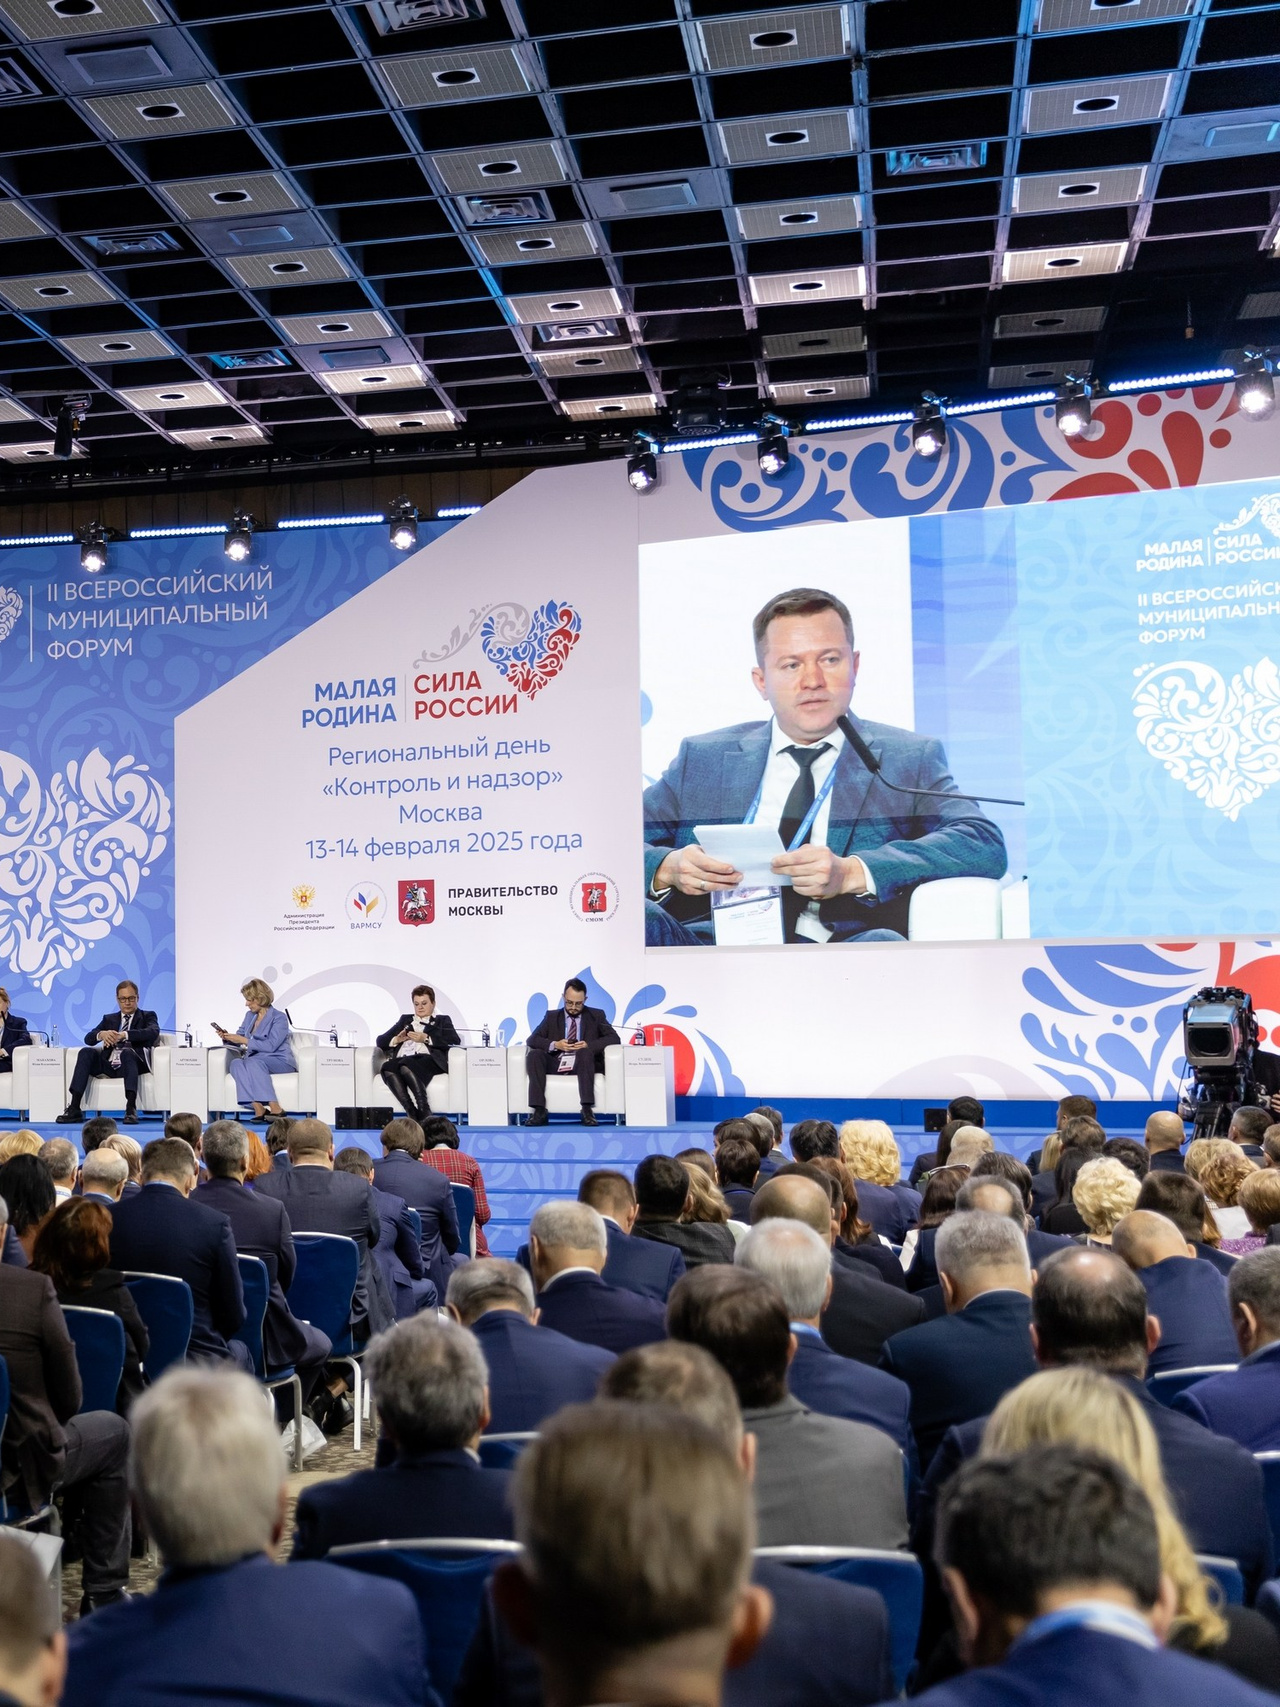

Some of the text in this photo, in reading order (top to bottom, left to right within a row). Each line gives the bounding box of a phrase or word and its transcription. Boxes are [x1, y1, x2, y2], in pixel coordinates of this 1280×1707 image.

[1145, 538, 1203, 556] МАЛАЯ
[1214, 533, 1262, 549] СИЛА
[1136, 554, 1204, 572] РОДИНА
[48, 565, 273, 602] II ВСЕРОССИЙСКИЙ
[1138, 594, 1148, 606] II
[48, 594, 268, 632] МУНИЦИПАЛЬНЫЙ
[1139, 627, 1206, 644] ФОРУМ
[47, 638, 132, 660] ФОРУМ
[315, 677, 396, 702] МАЛАЯ
[414, 671, 482, 694] СИЛА
[302, 703, 397, 728] РОДИНА
[414, 694, 518, 720] РОССИИ
[328, 736, 551, 766] Региональный день
[322, 770, 562, 798] «Контроль и надзор»
[399, 804, 482, 824] Москва
[306, 830, 582, 862] 13-14 февраля 2025 года
[448, 885, 558, 898] ПРАВИТЕЛЬСТВО
[448, 905, 504, 916] МОСКВЫ
[350, 922, 382, 930] ВАРМСУ
